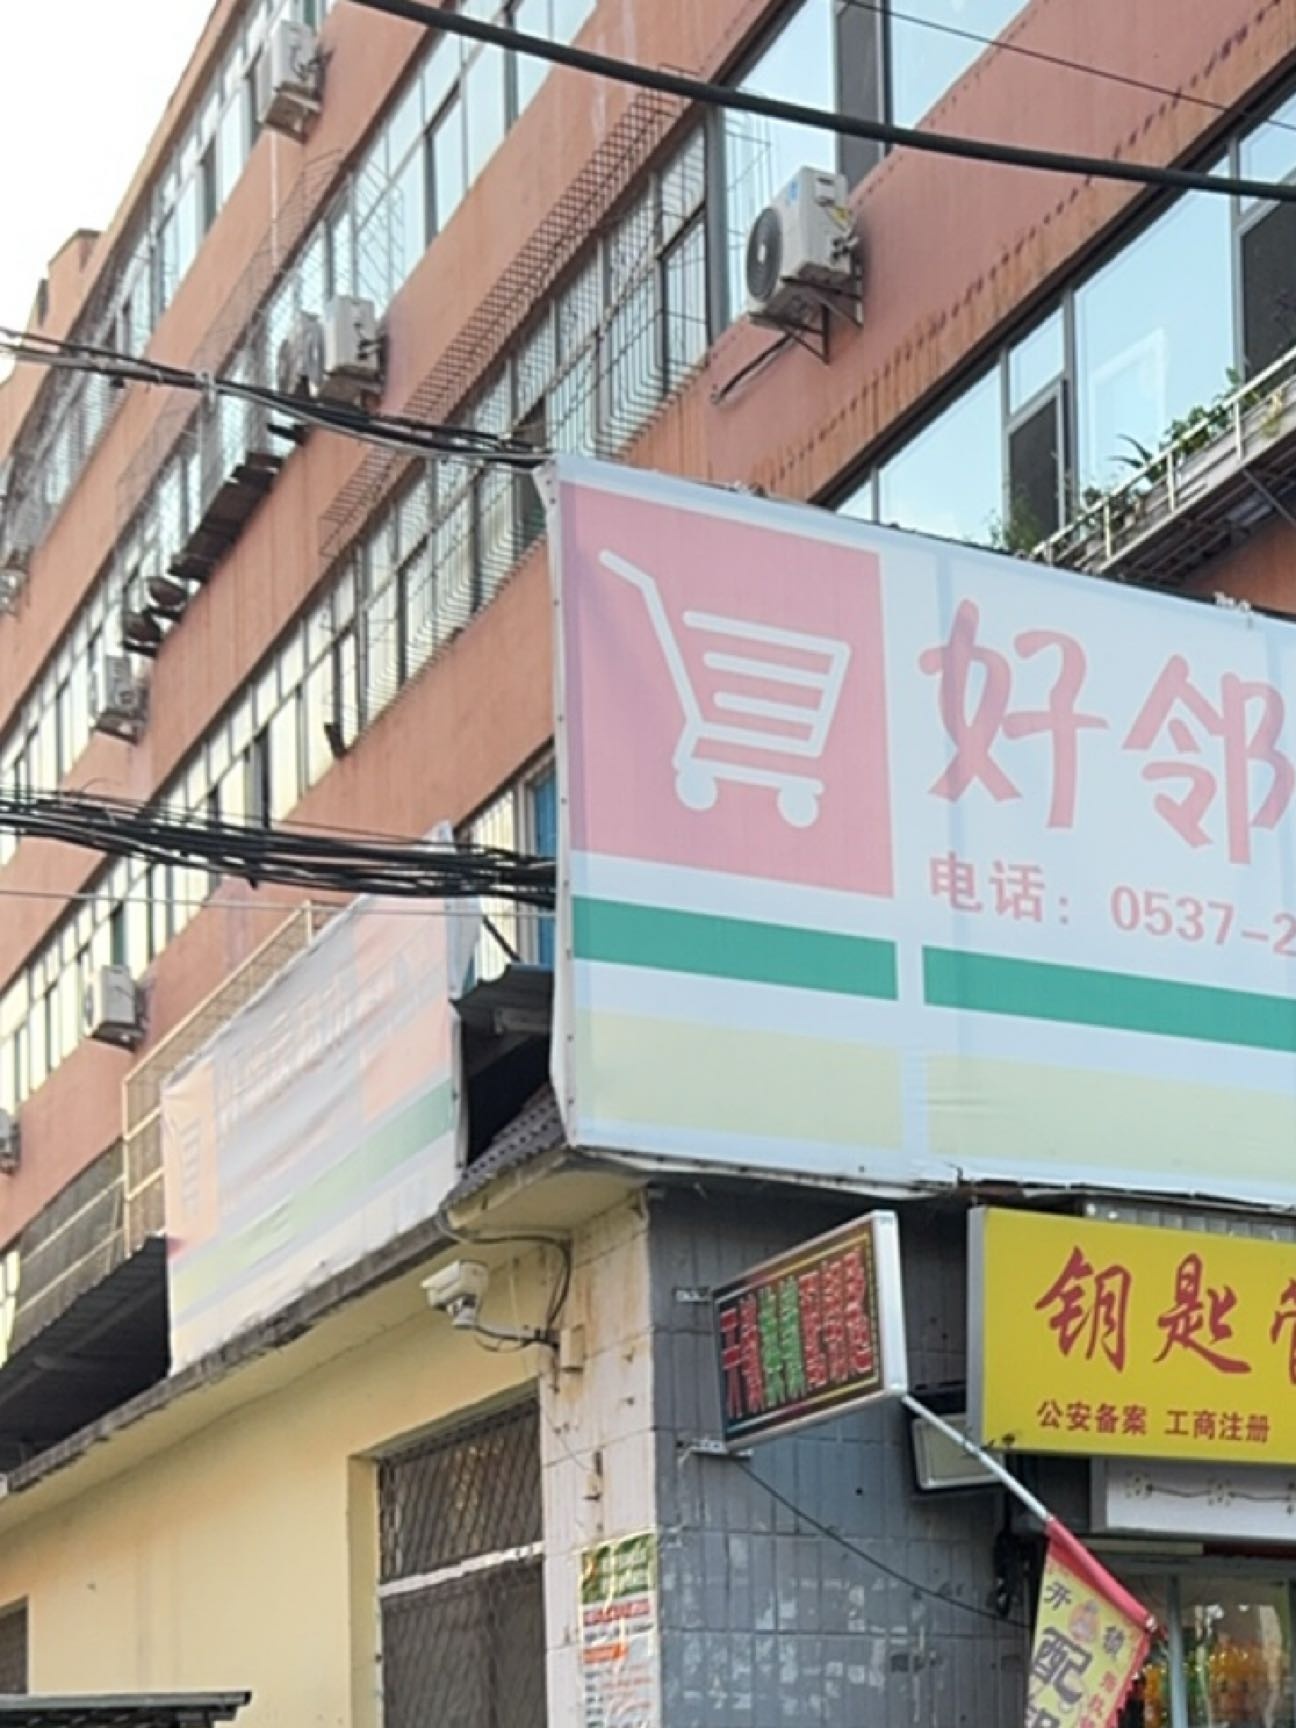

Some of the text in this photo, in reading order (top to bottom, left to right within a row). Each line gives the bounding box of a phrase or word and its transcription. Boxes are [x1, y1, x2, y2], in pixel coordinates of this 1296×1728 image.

[1037, 1400, 1147, 1436] 公安备案
[1165, 1409, 1270, 1443] 工商注册
